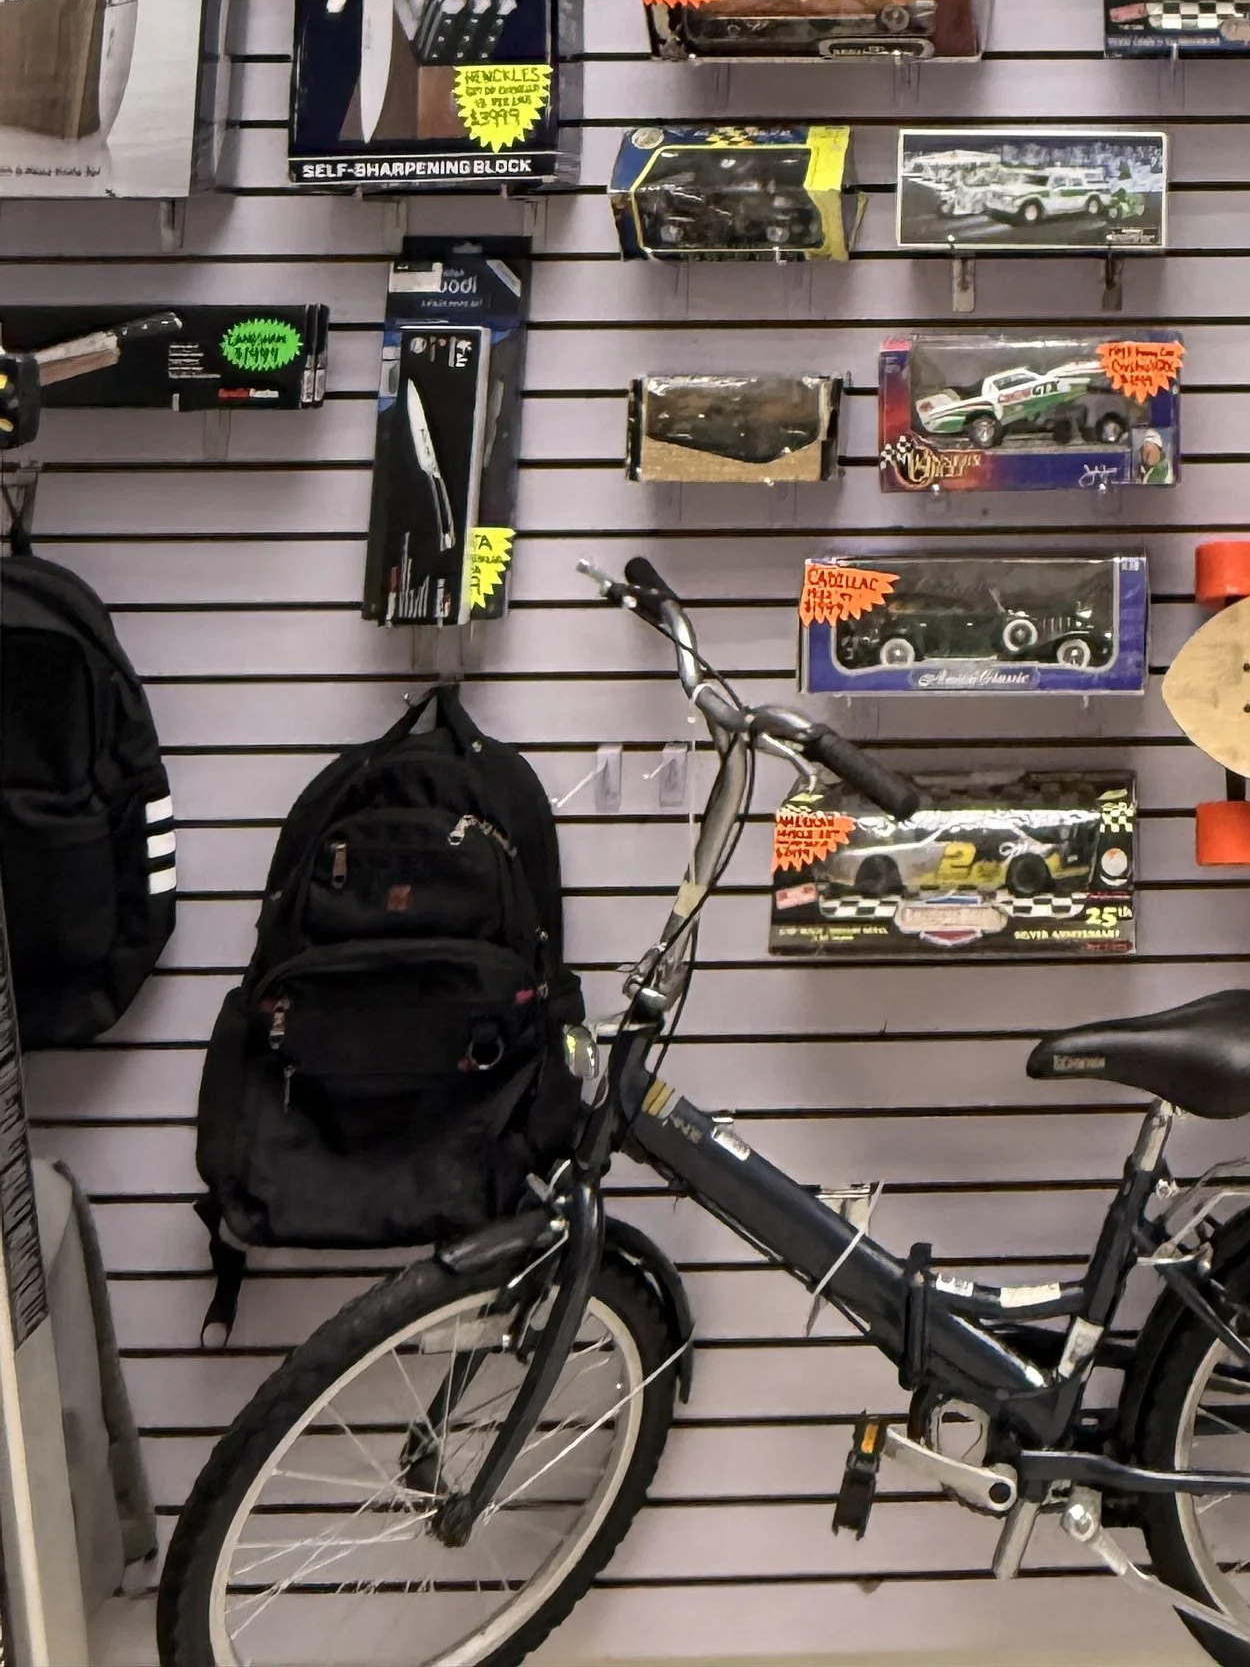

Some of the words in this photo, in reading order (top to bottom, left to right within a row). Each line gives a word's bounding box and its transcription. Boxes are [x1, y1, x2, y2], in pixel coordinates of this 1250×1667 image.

[302, 161, 471, 179] SELF-SHARPENING
[473, 158, 532, 174] BLOCK
[807, 566, 880, 592] CADILLAC
